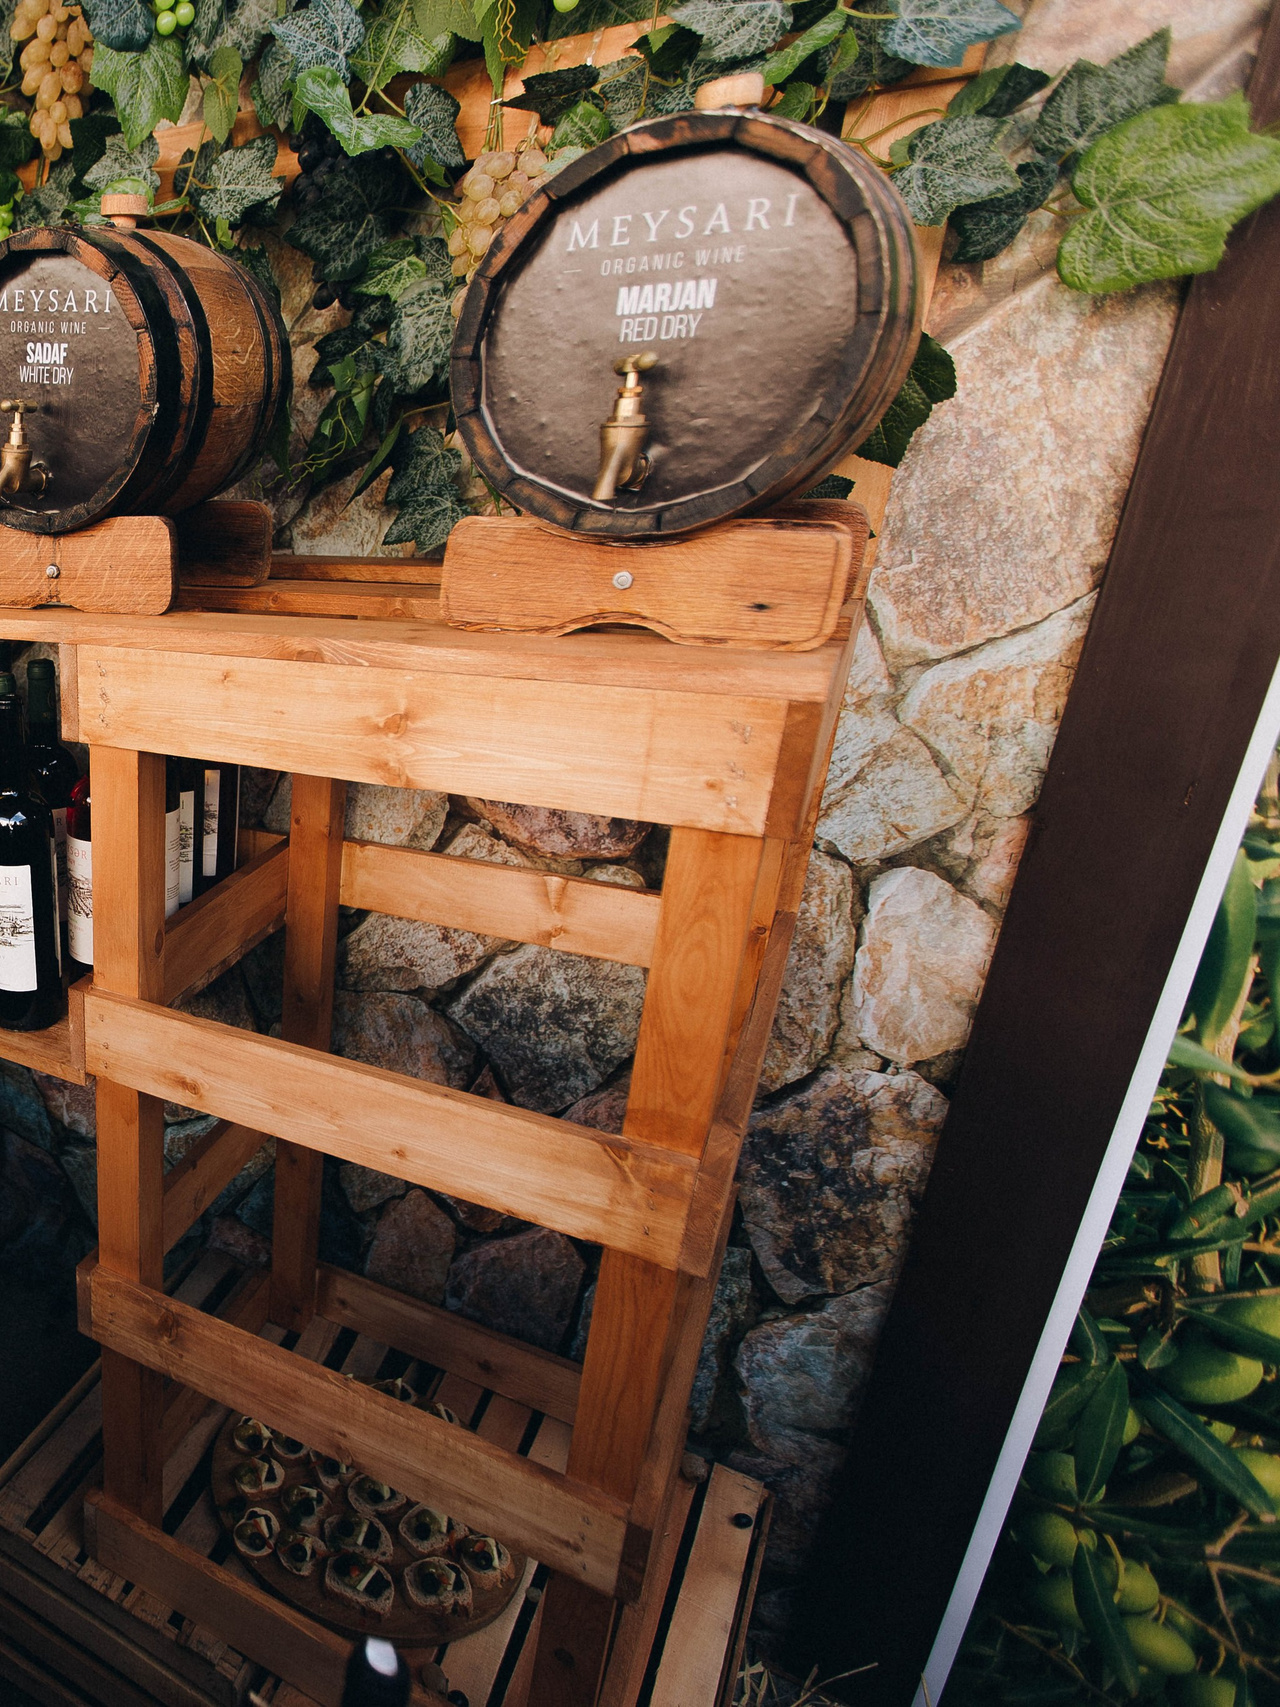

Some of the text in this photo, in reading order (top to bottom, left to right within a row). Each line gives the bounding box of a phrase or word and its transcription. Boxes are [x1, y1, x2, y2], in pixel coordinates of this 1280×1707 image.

[565, 193, 802, 252] MEYSARI
[600, 245, 747, 277] ORGANIC WINE
[616, 278, 718, 316] MARJAN
[10, 320, 87, 335] ORGANIC WINE
[619, 313, 703, 343] RED DRY
[26, 342, 68, 365] SADAF
[19, 366, 74, 385] WHITE DRY
